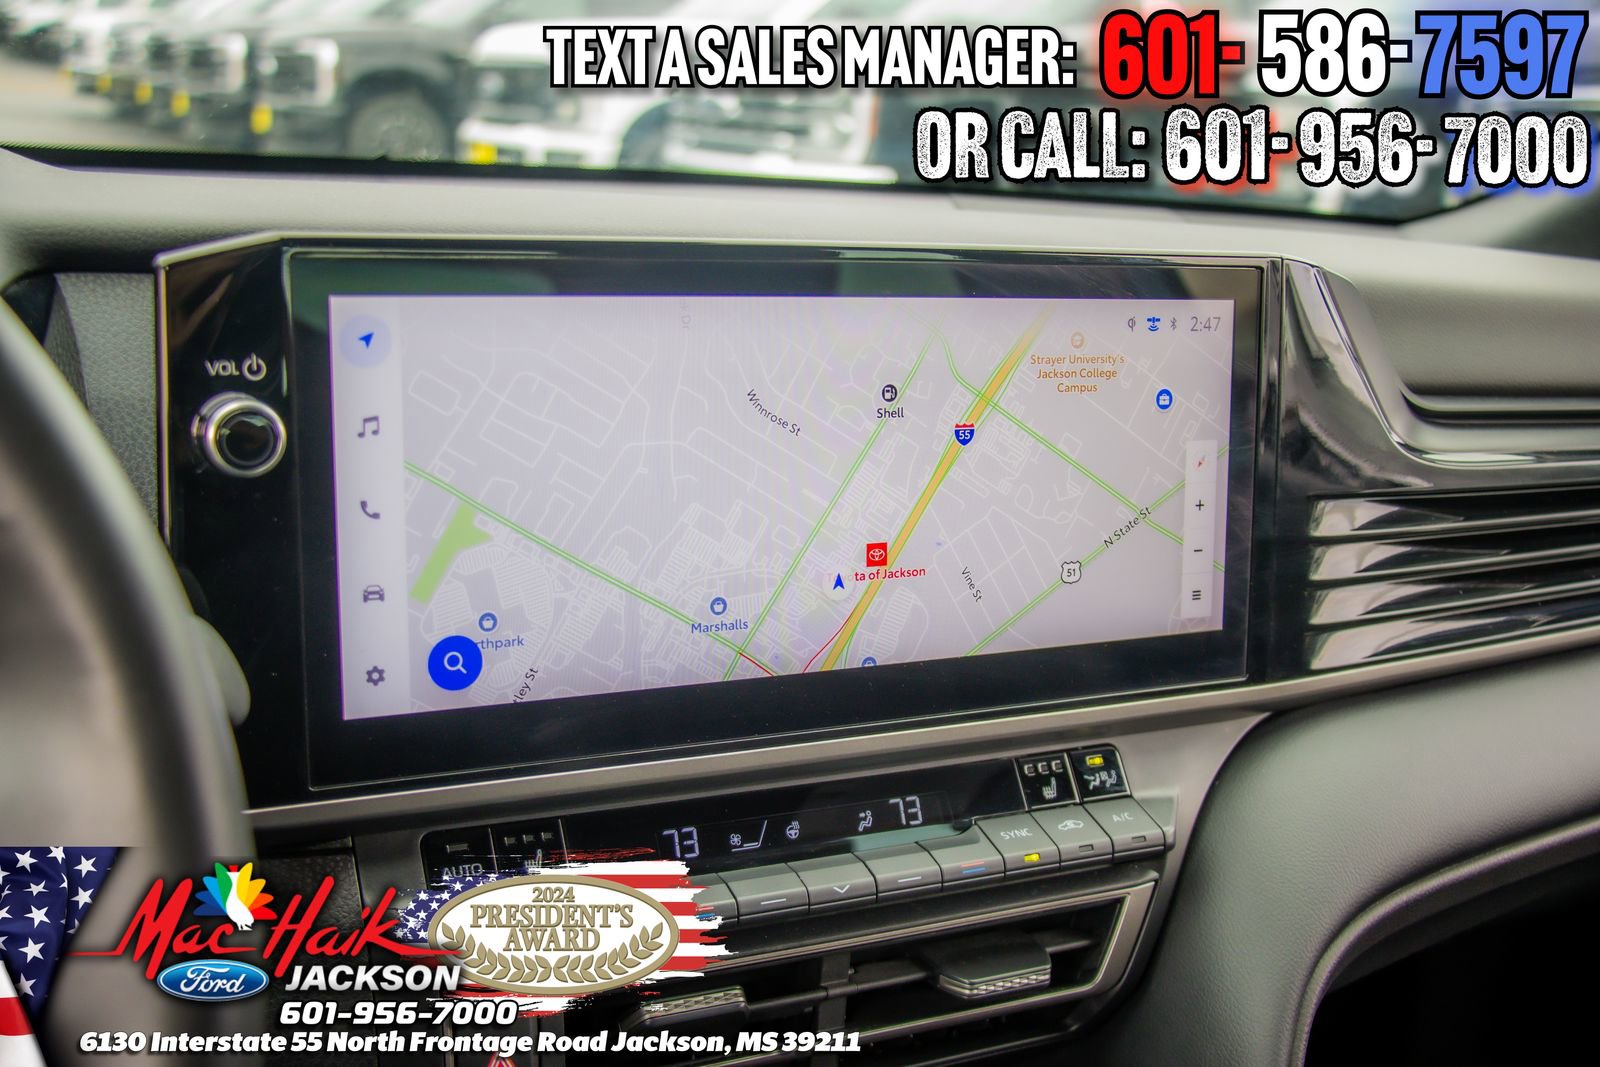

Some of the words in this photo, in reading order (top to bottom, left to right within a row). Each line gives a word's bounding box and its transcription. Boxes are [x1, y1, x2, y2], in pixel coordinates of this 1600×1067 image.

[1190, 316, 1221, 332] 2:47
[1030, 355, 1066, 365] Strayer
[1069, 353, 1125, 364] University's
[205, 359, 240, 376] VOL
[1037, 369, 1077, 379] Jackson
[1079, 368, 1118, 380] College
[1057, 383, 1098, 394] Campus
[747, 389, 789, 429] Winnrose
[789, 423, 801, 437] St
[876, 407, 905, 418] Shell
[959, 430, 971, 440] 55
[1104, 536, 1114, 548] N
[1113, 517, 1139, 540] State
[1140, 507, 1151, 520] St
[868, 569, 881, 580] of
[882, 567, 926, 580] Jackson
[1066, 568, 1076, 577] 51
[961, 566, 976, 591] Vine
[972, 589, 982, 603] St
[691, 618, 749, 634] Marshalls
[525, 668, 538, 681] St
[889, 796, 923, 826] 73
[1112, 811, 1134, 823] A/C
[1000, 828, 1033, 841] SYNC
[662, 826, 700, 858] 73
[442, 862, 484, 879] AUTO
